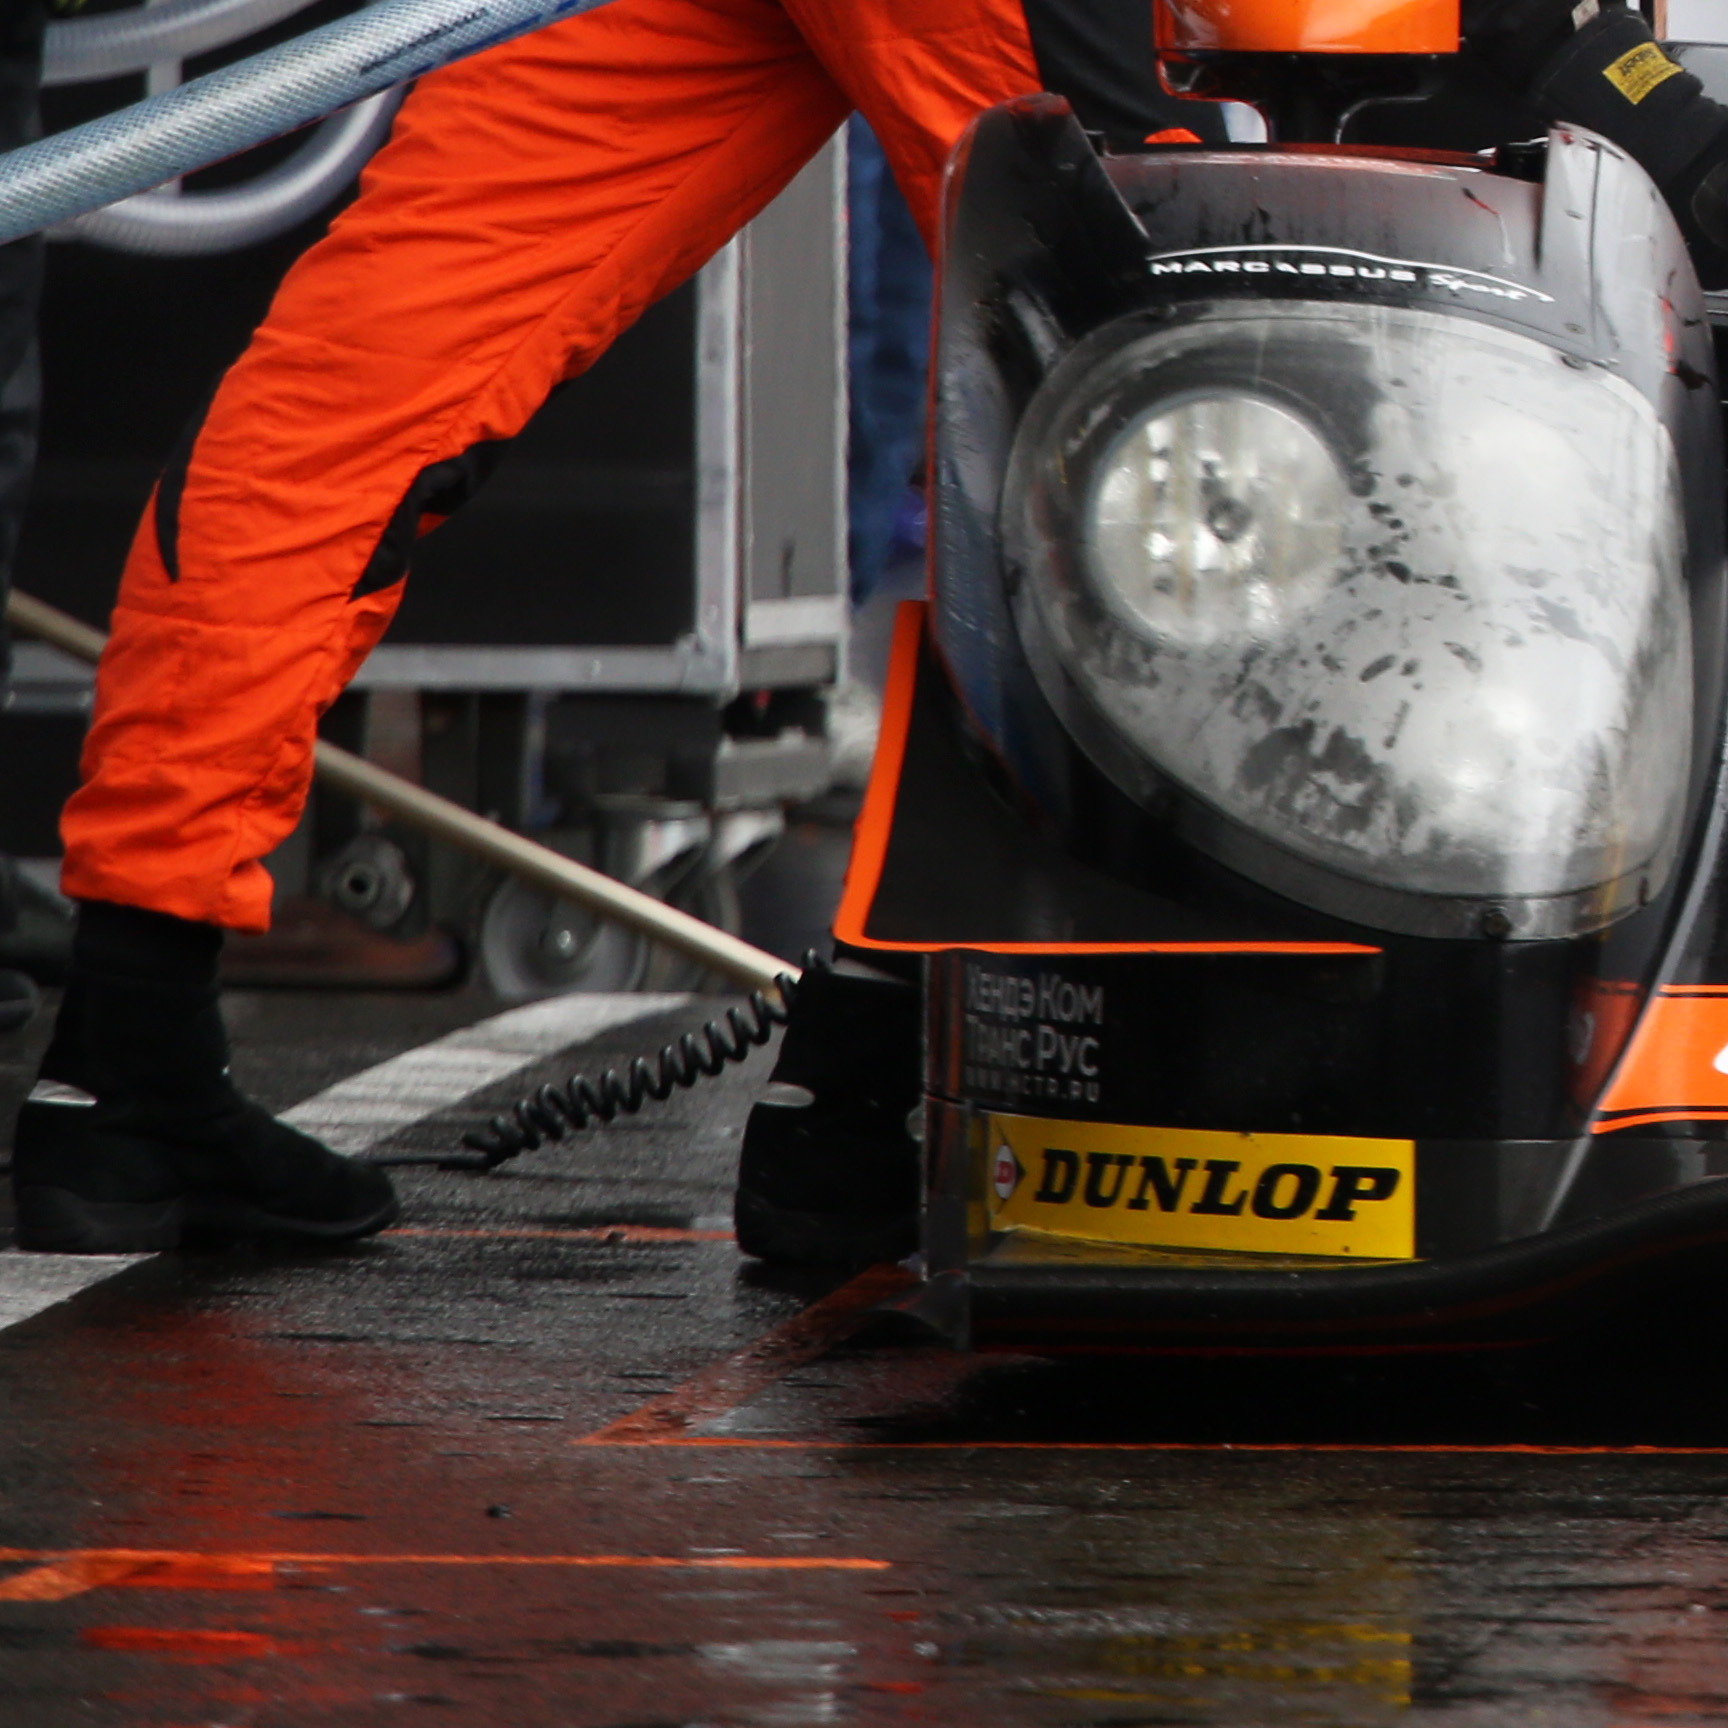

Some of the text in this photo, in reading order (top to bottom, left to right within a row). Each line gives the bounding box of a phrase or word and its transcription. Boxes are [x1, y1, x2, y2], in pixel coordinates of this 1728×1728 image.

[1152, 260, 1529, 301] MARCASSUS Sport
[1034, 1148, 1403, 1222] DUNLOP
